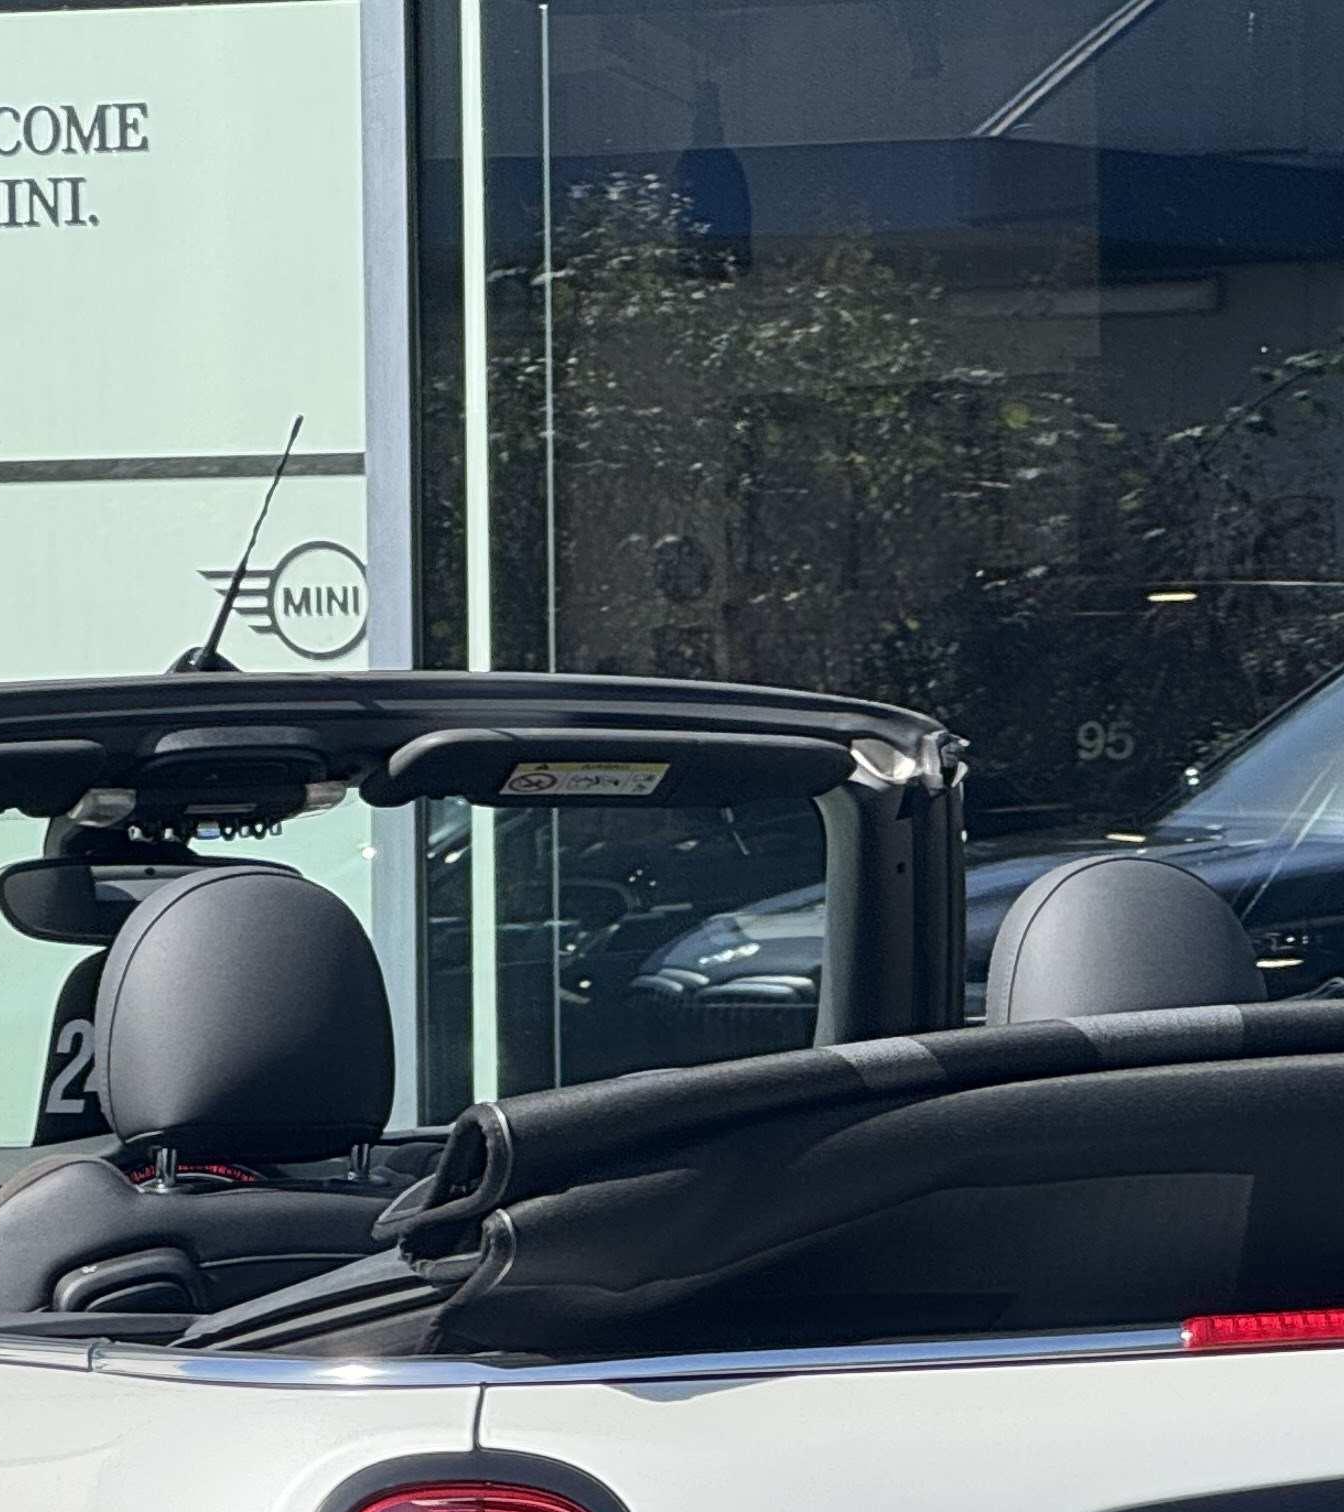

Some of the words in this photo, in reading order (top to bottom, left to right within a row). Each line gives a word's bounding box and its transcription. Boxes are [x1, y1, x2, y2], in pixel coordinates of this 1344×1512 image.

[283, 586, 360, 616] MINI
[1077, 720, 1135, 760] 95
[45, 1018, 98, 1114] 2
